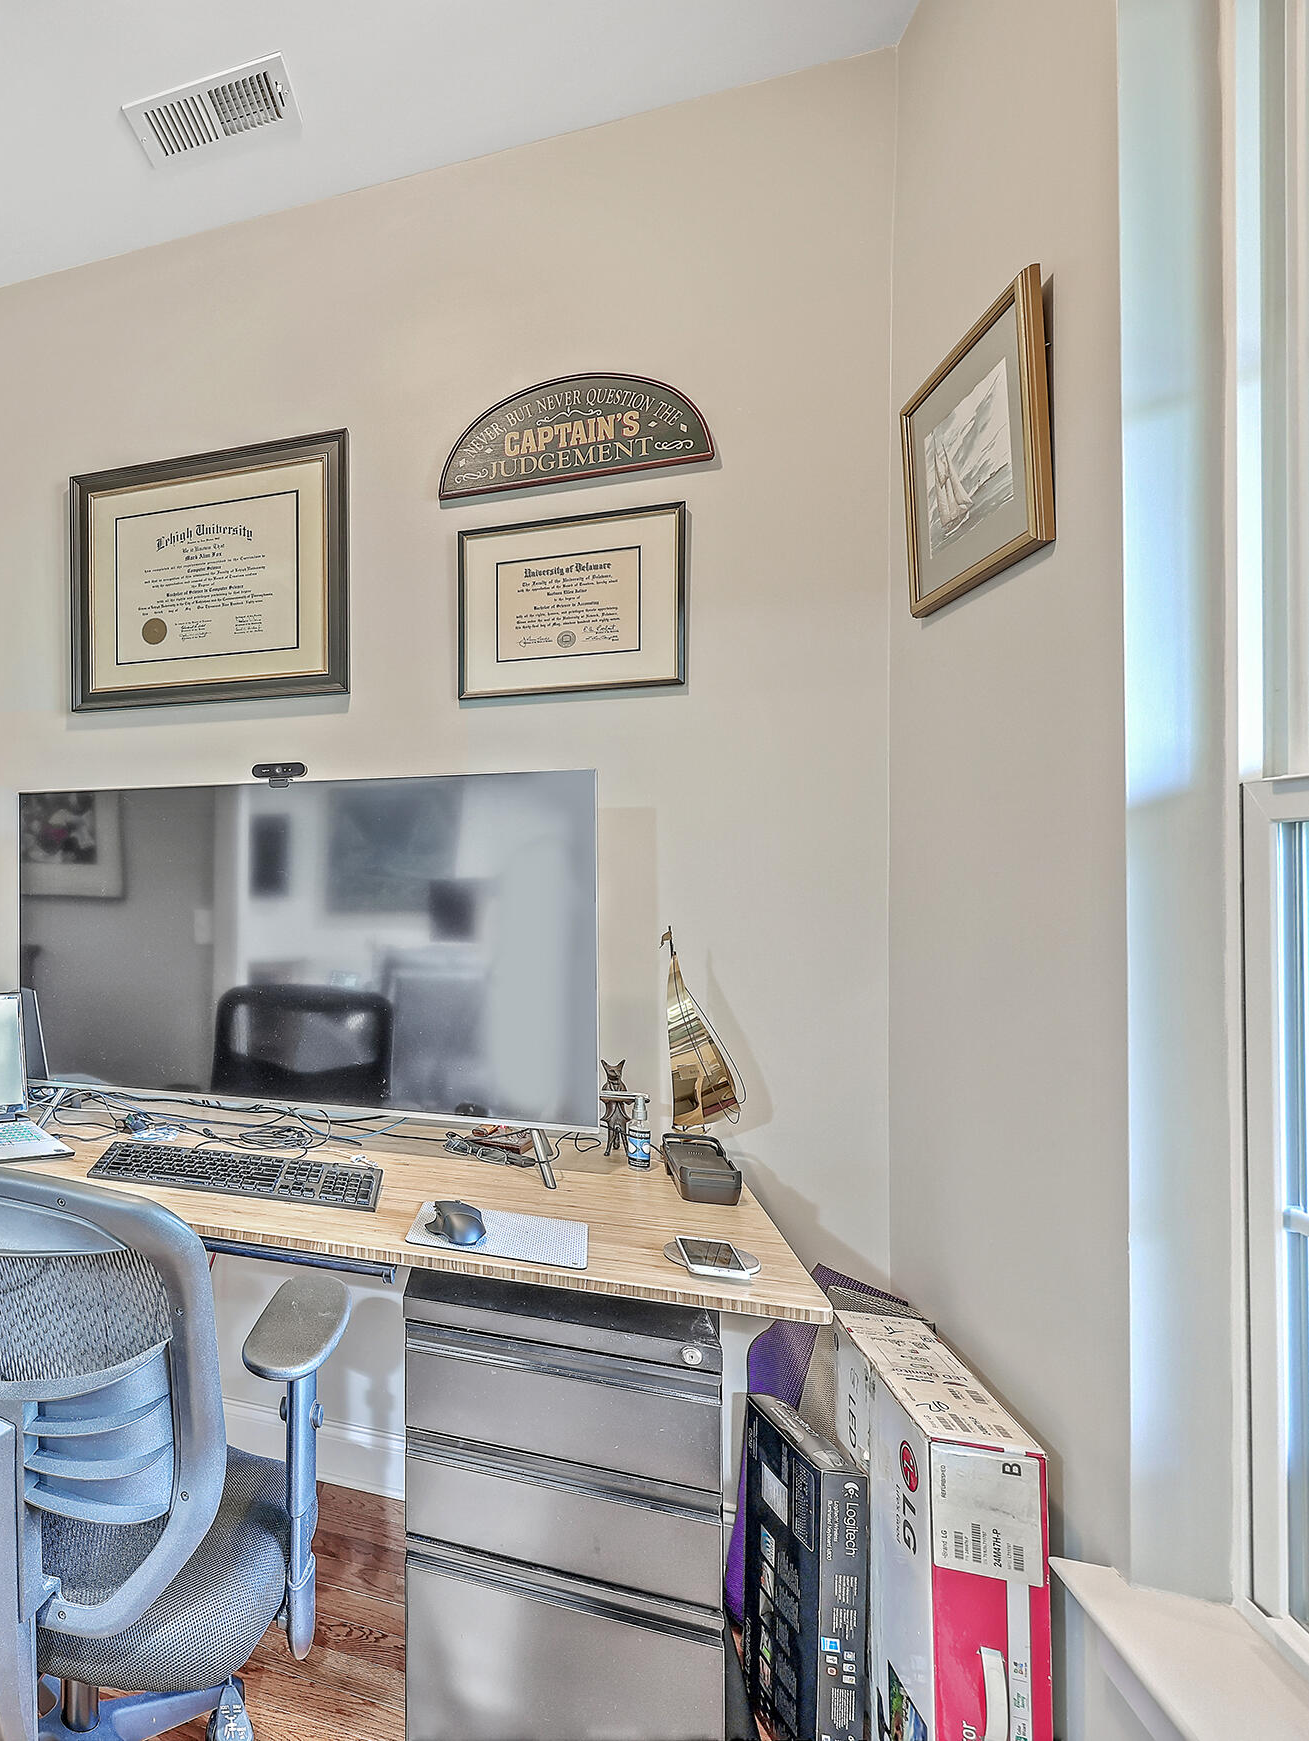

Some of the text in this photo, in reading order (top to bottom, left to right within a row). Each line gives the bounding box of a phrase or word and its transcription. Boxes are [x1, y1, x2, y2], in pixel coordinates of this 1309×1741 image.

[463, 388, 683, 459] NEVER, BUT NEVER QUESTION THE
[503, 410, 641, 457] CAPTAIN'S
[488, 436, 655, 480] JUDGEMENT
[156, 523, 253, 552] Lehigh University
[524, 562, 612, 578] University of Delaware
[848, 1393, 857, 1449] LED
[1002, 1462, 1021, 1477] B
[843, 1502, 859, 1556] Logitech
[902, 1493, 917, 1556] LG
